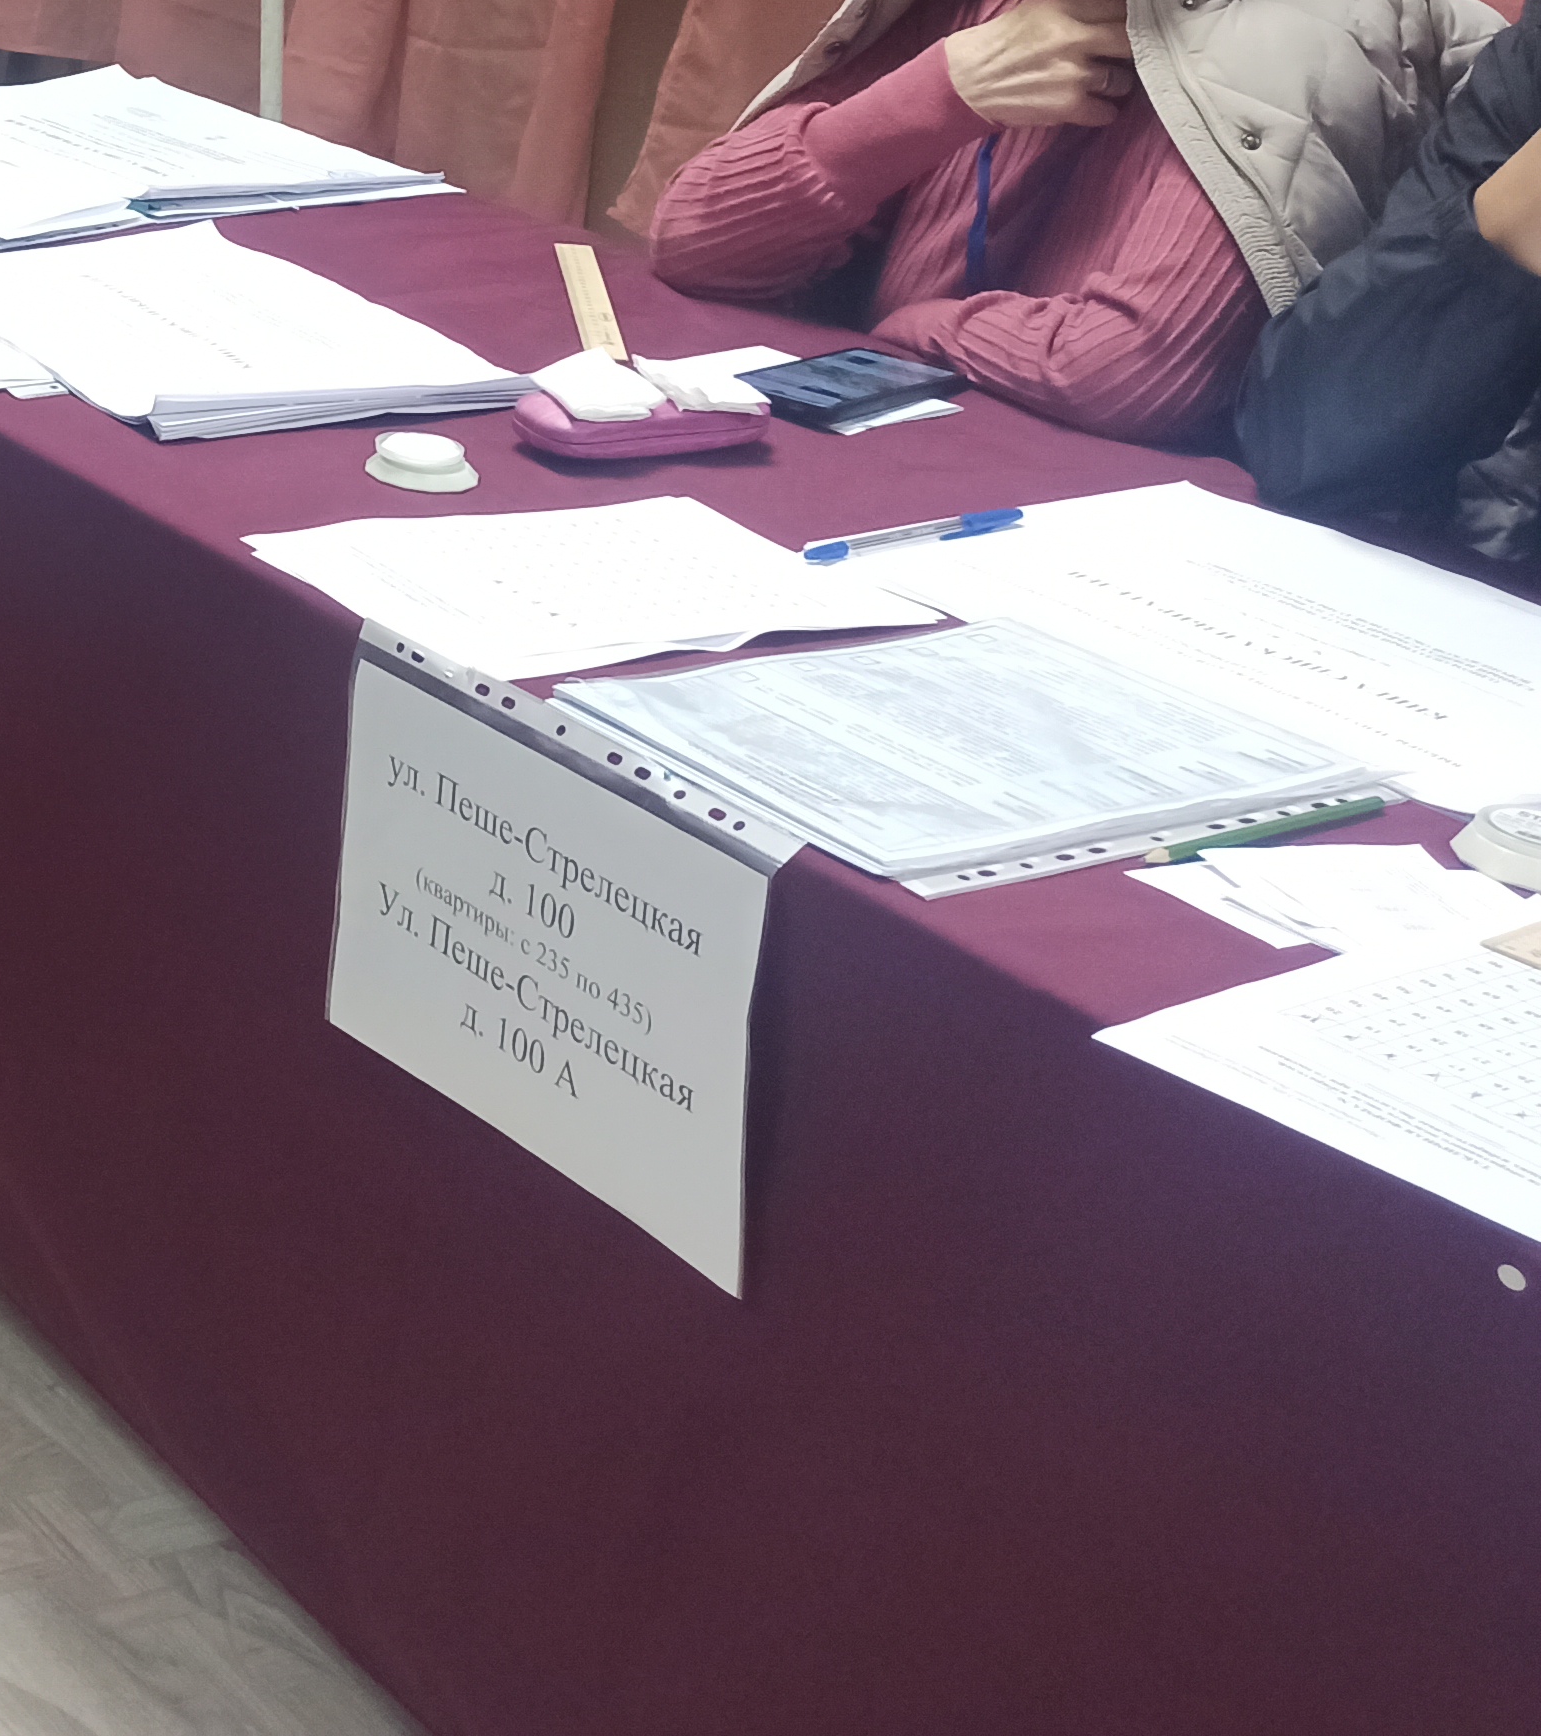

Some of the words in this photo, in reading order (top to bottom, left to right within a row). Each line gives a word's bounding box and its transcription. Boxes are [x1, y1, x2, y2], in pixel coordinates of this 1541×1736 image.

[387, 754, 425, 797] ул.
[434, 771, 703, 958] Пеше-Стрелецкая
[488, 871, 513, 905] д.
[526, 883, 575, 939] 100
[378, 881, 419, 938] Ул.
[429, 914, 694, 1114] Пеше-Стрелецкая
[520, 938, 531, 955] с
[535, 941, 570, 980] 235
[575, 972, 601, 999] по
[606, 987, 652, 1035] 435)
[459, 1003, 484, 1038] д.
[498, 1017, 545, 1074] 100
[554, 1059, 579, 1100] А
